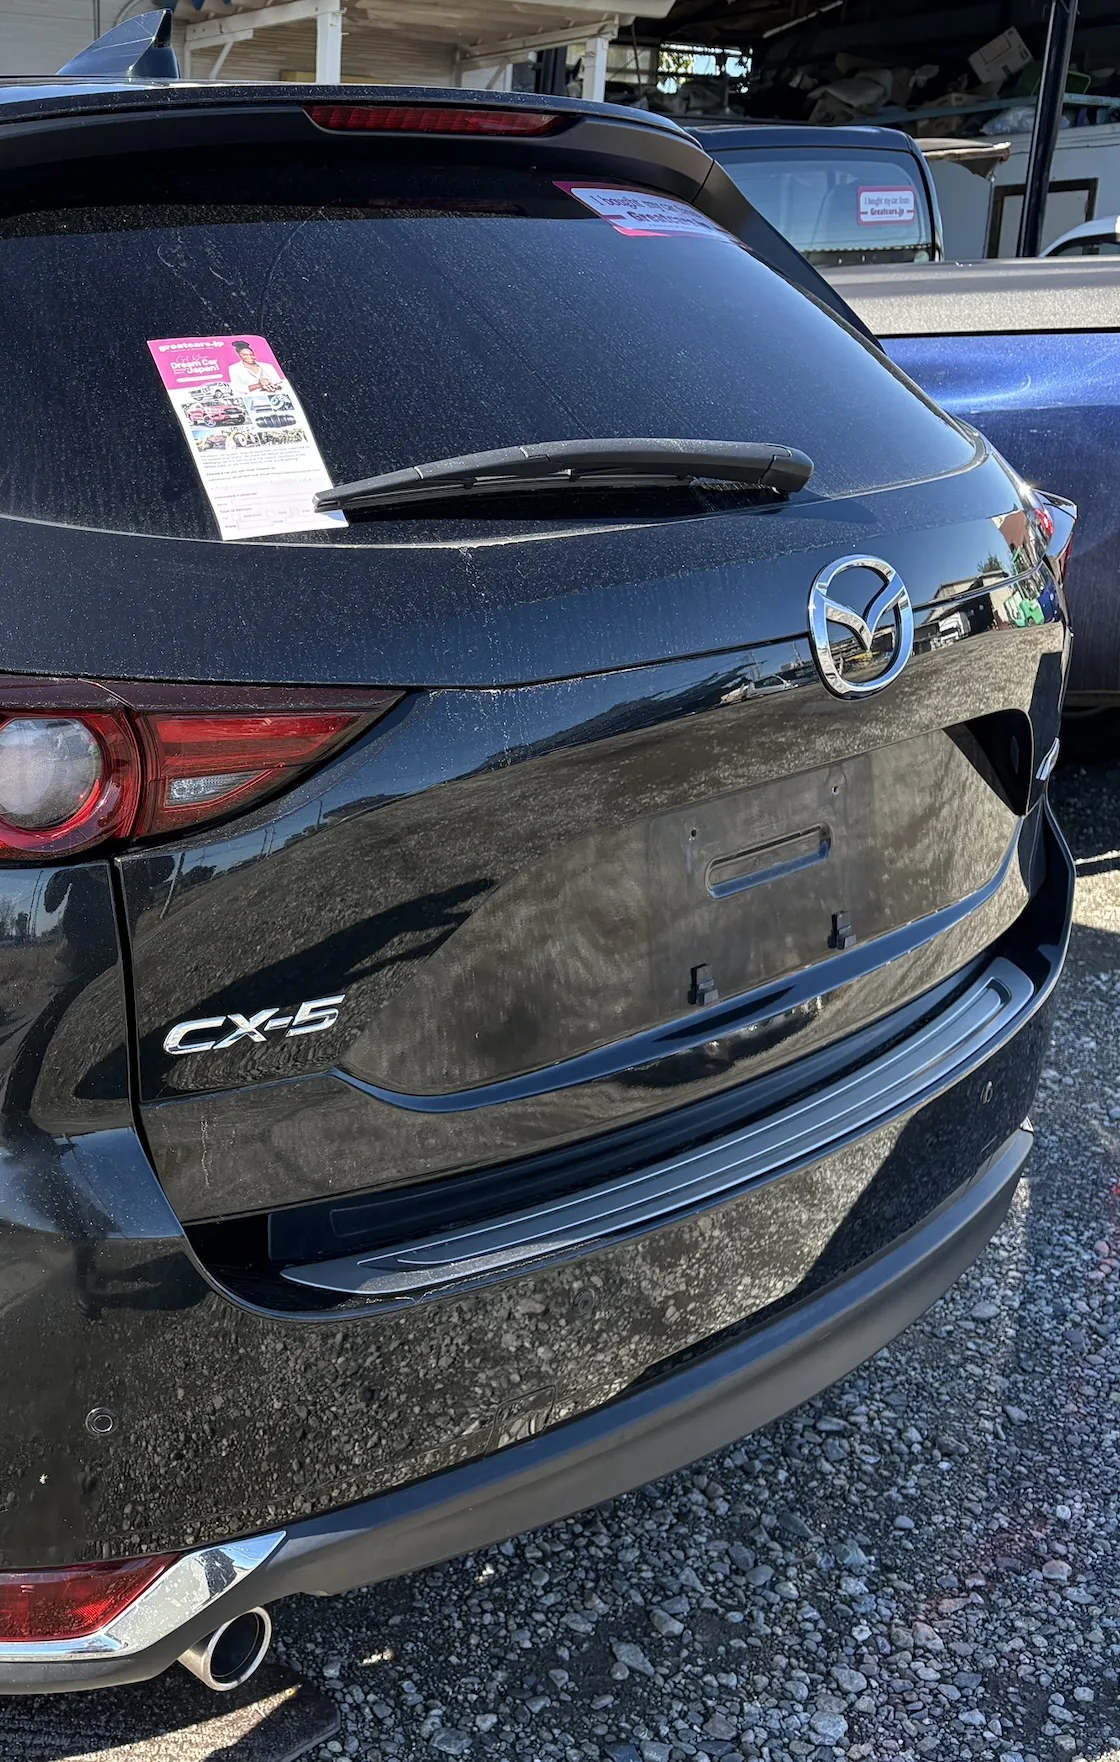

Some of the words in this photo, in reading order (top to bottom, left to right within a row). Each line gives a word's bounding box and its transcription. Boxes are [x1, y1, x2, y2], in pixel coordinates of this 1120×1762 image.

[596, 195, 645, 209] bought
[871, 207, 904, 217] Greatcars.jp
[170, 360, 201, 370] Dream
[162, 993, 346, 1056] CX-5
